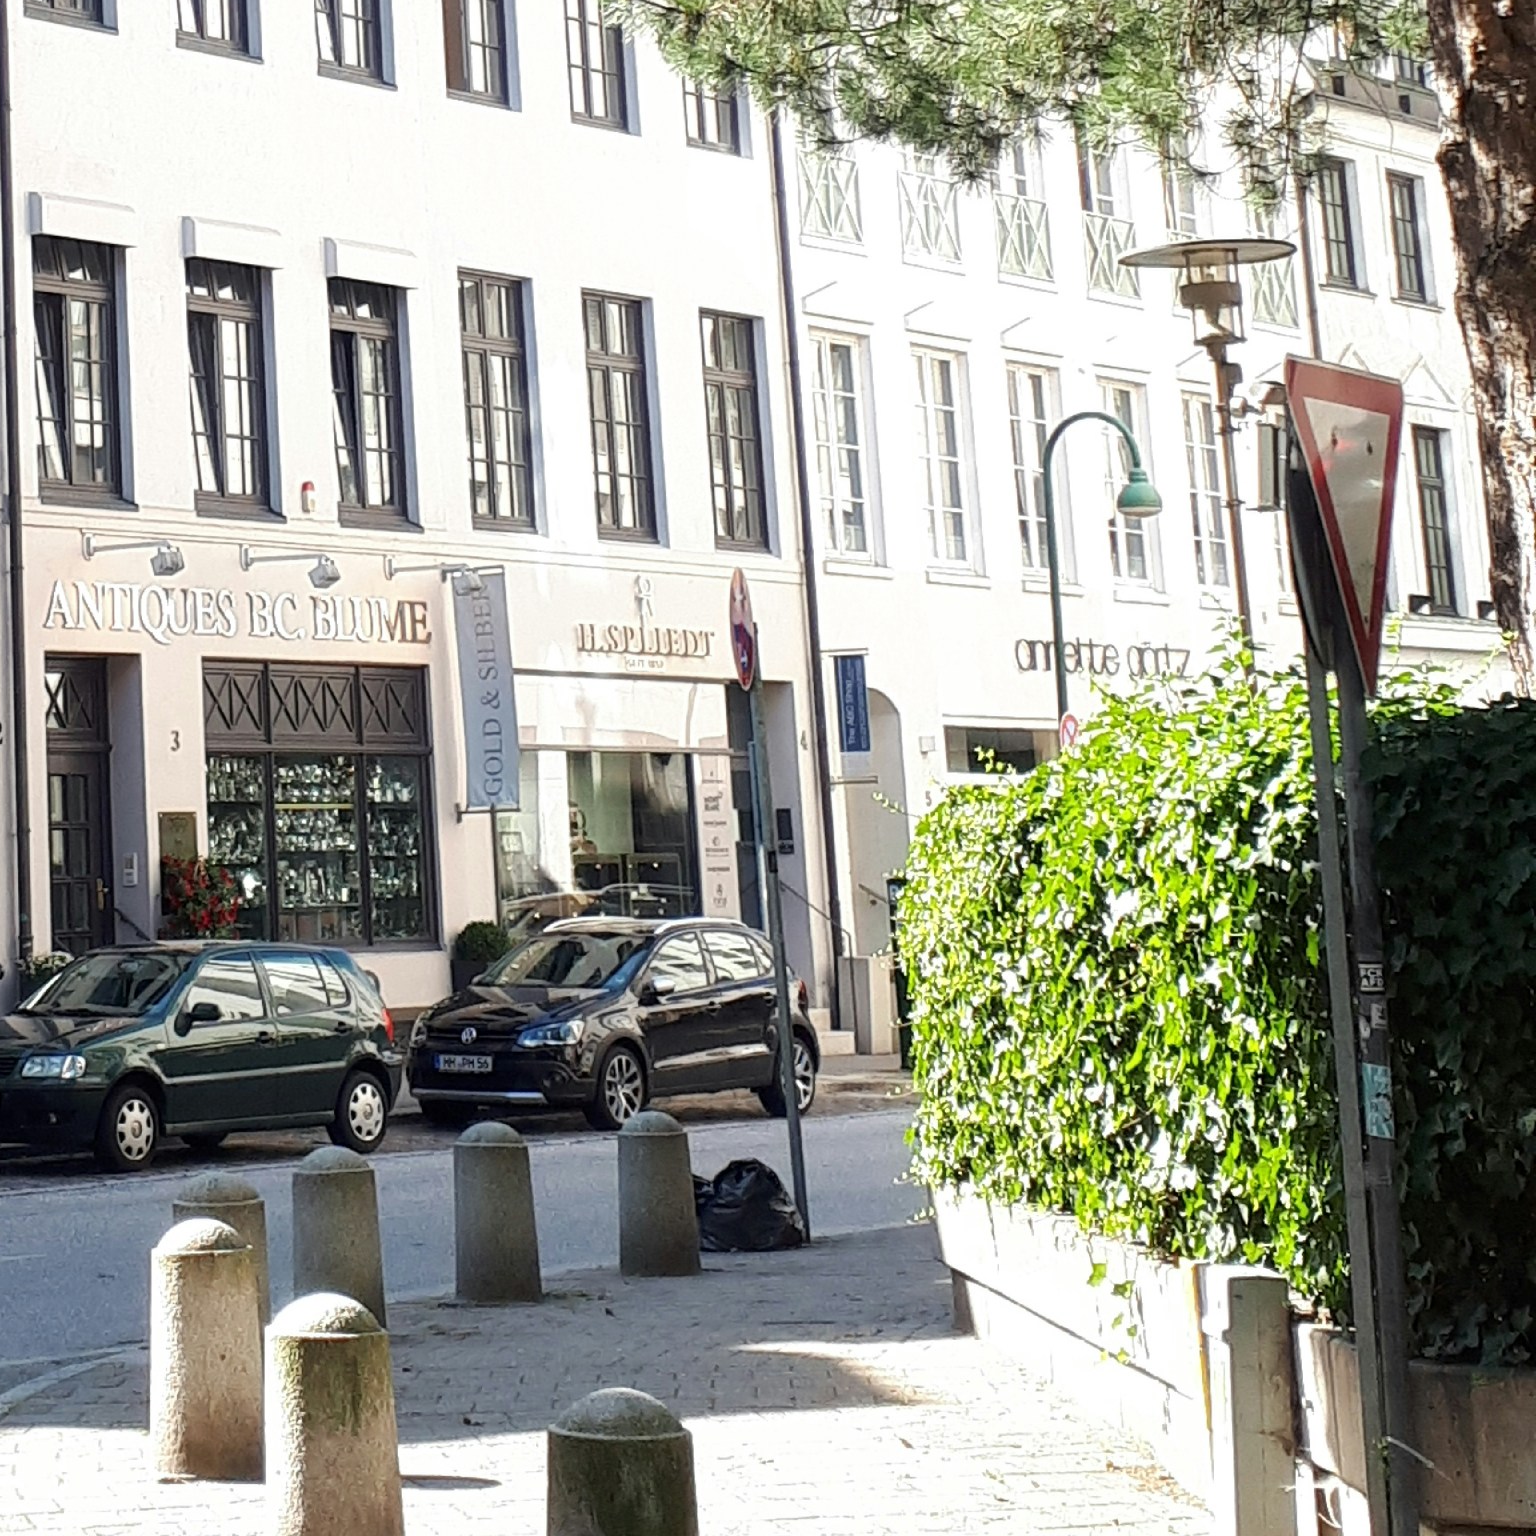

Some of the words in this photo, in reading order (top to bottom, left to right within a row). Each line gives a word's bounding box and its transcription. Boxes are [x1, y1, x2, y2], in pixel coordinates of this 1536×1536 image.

[43, 579, 237, 644] ANTIQUES
[309, 594, 432, 645] BLUME
[471, 580, 500, 681] SILBER
[480, 689, 501, 710] &
[170, 729, 182, 752] 3
[482, 717, 505, 797] GOLD
